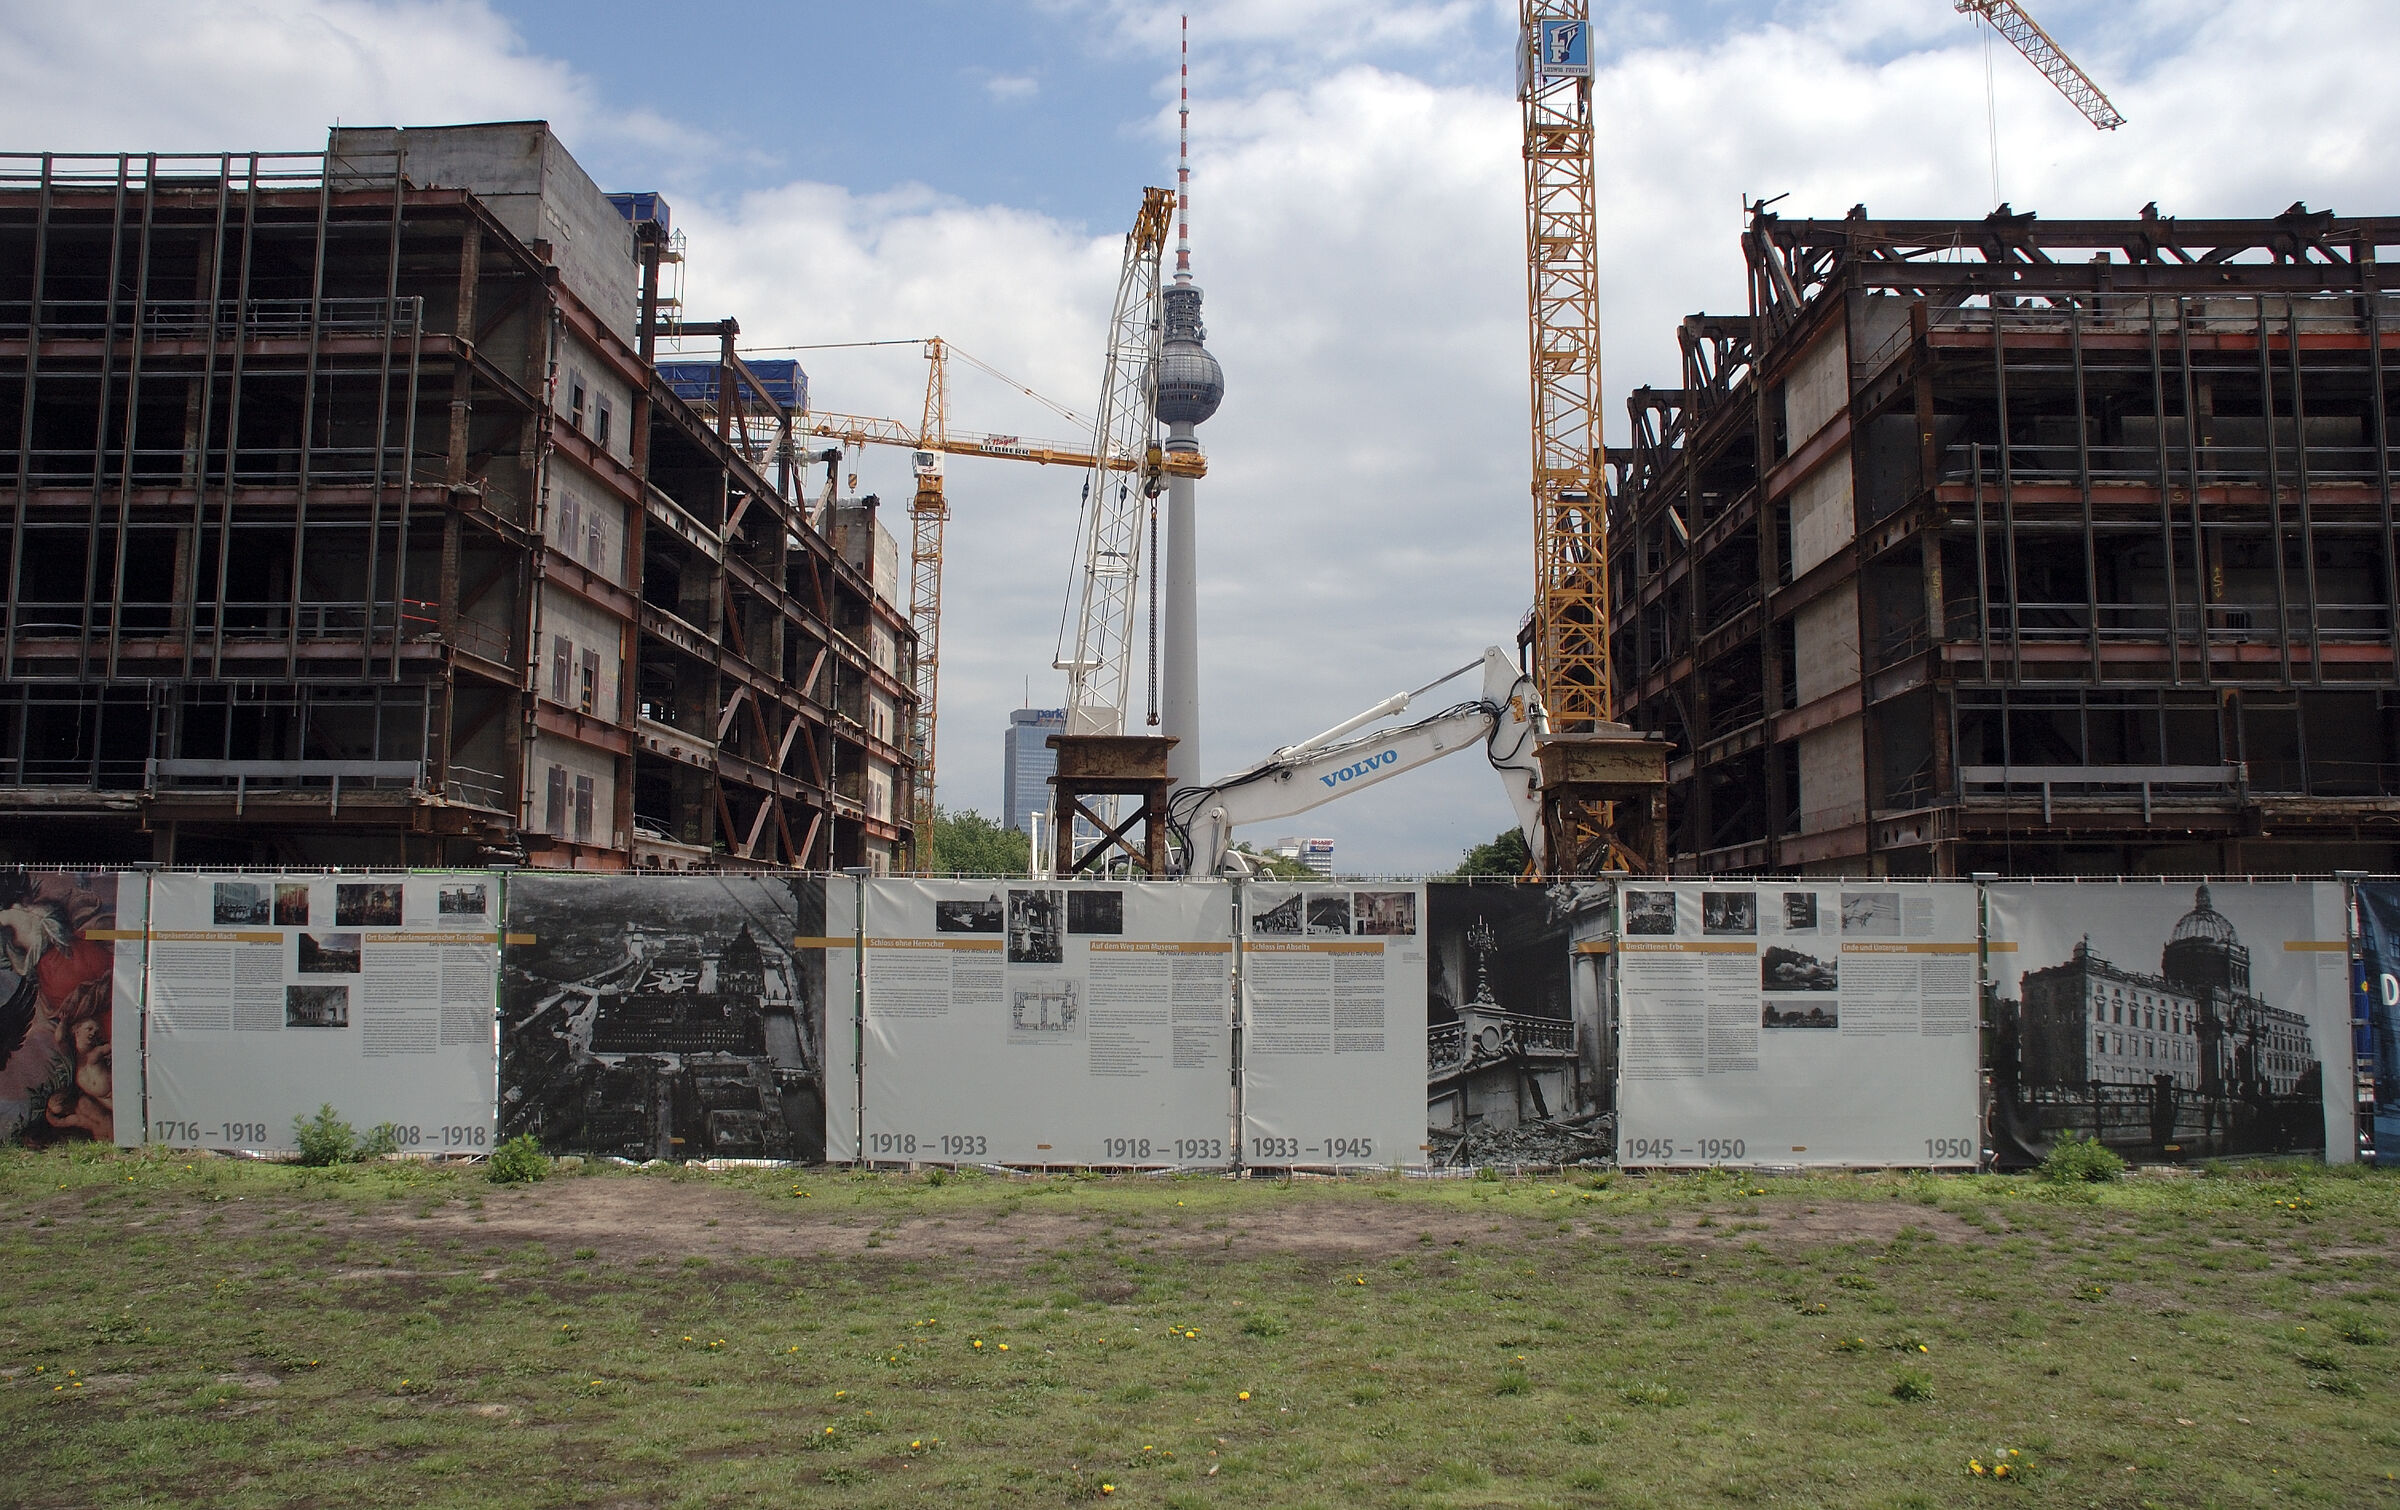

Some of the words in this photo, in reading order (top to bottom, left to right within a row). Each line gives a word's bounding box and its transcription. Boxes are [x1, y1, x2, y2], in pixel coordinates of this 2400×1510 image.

[980, 444, 1029, 456] LIEBHERR
[1319, 749, 1398, 787] VOLVO
[206, 932, 217, 940] der
[870, 939, 894, 947] Schloss
[912, 940, 945, 948] Herrscher
[1119, 943, 1135, 952] Weg
[1150, 943, 1180, 951] Museum
[1251, 943, 1276, 951] Schloss
[1276, 943, 1286, 951] im
[1286, 943, 1310, 951] Abseits
[1842, 943, 1859, 951] Ende
[1873, 944, 1908, 953] Untergang
[2380, 973, 2400, 1006] D
[156, 1121, 200, 1141] 1716
[222, 1122, 267, 1143] 1918
[441, 1126, 486, 1146] 1918
[869, 1133, 917, 1154] 1918
[940, 1135, 988, 1156] 1933
[1103, 1138, 1151, 1159] 1918
[1174, 1139, 1222, 1159] 1933
[1252, 1137, 1299, 1158] 1933
[1324, 1138, 1372, 1158] 1945
[1625, 1138, 1674, 1159] 1945
[1697, 1138, 1746, 1159] 1950
[1924, 1138, 1972, 1159] 1950
